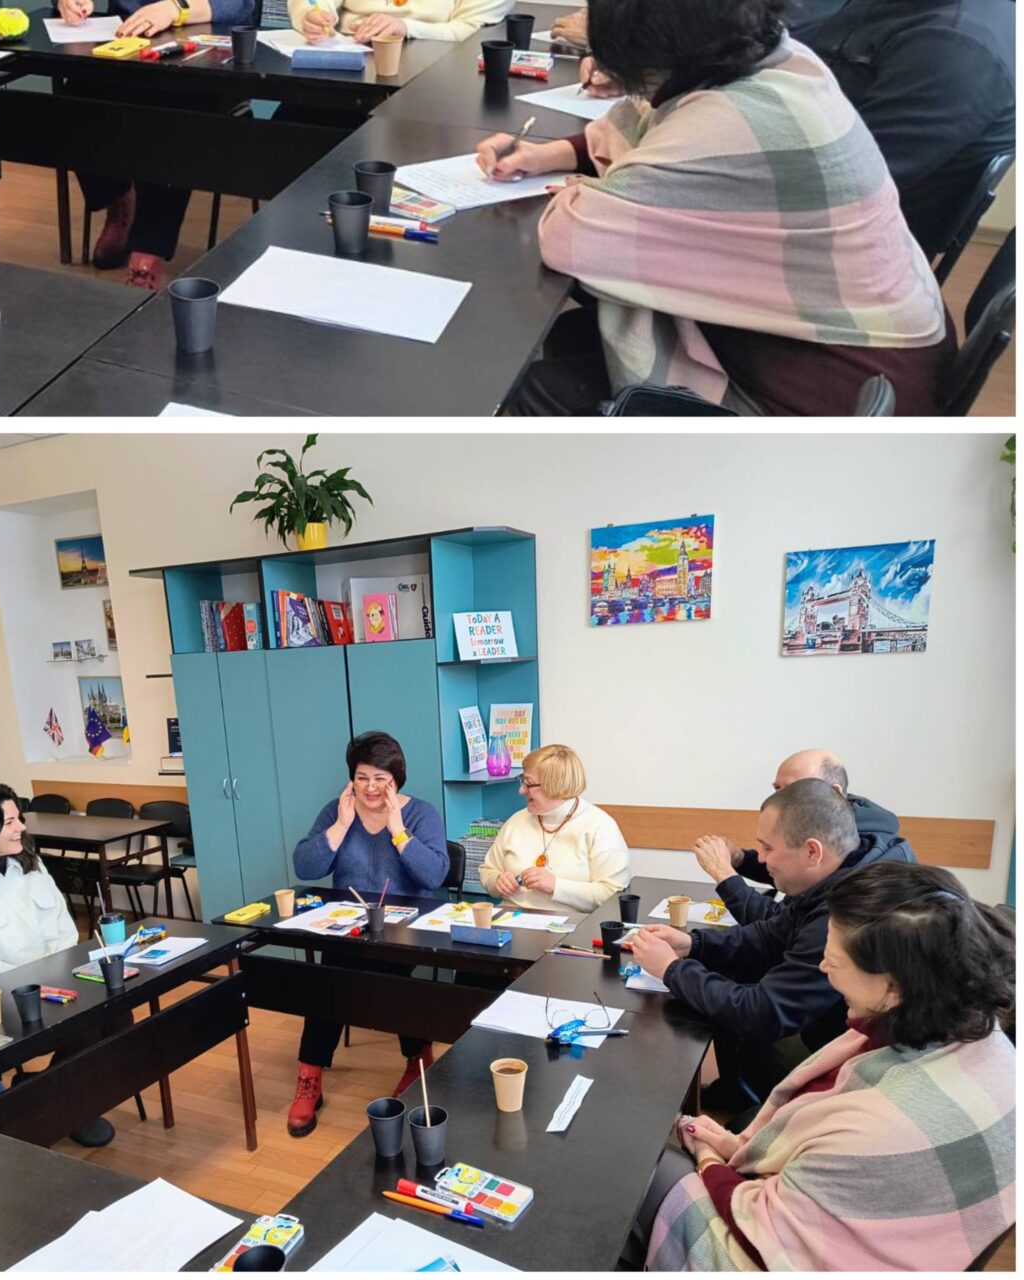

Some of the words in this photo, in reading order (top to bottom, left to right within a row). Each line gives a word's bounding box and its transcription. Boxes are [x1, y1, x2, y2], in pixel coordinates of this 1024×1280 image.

[494, 613, 500, 623] A
[468, 625, 503, 636] READER
[471, 638, 504, 646] tomorrow
[478, 647, 506, 656] LEADER
